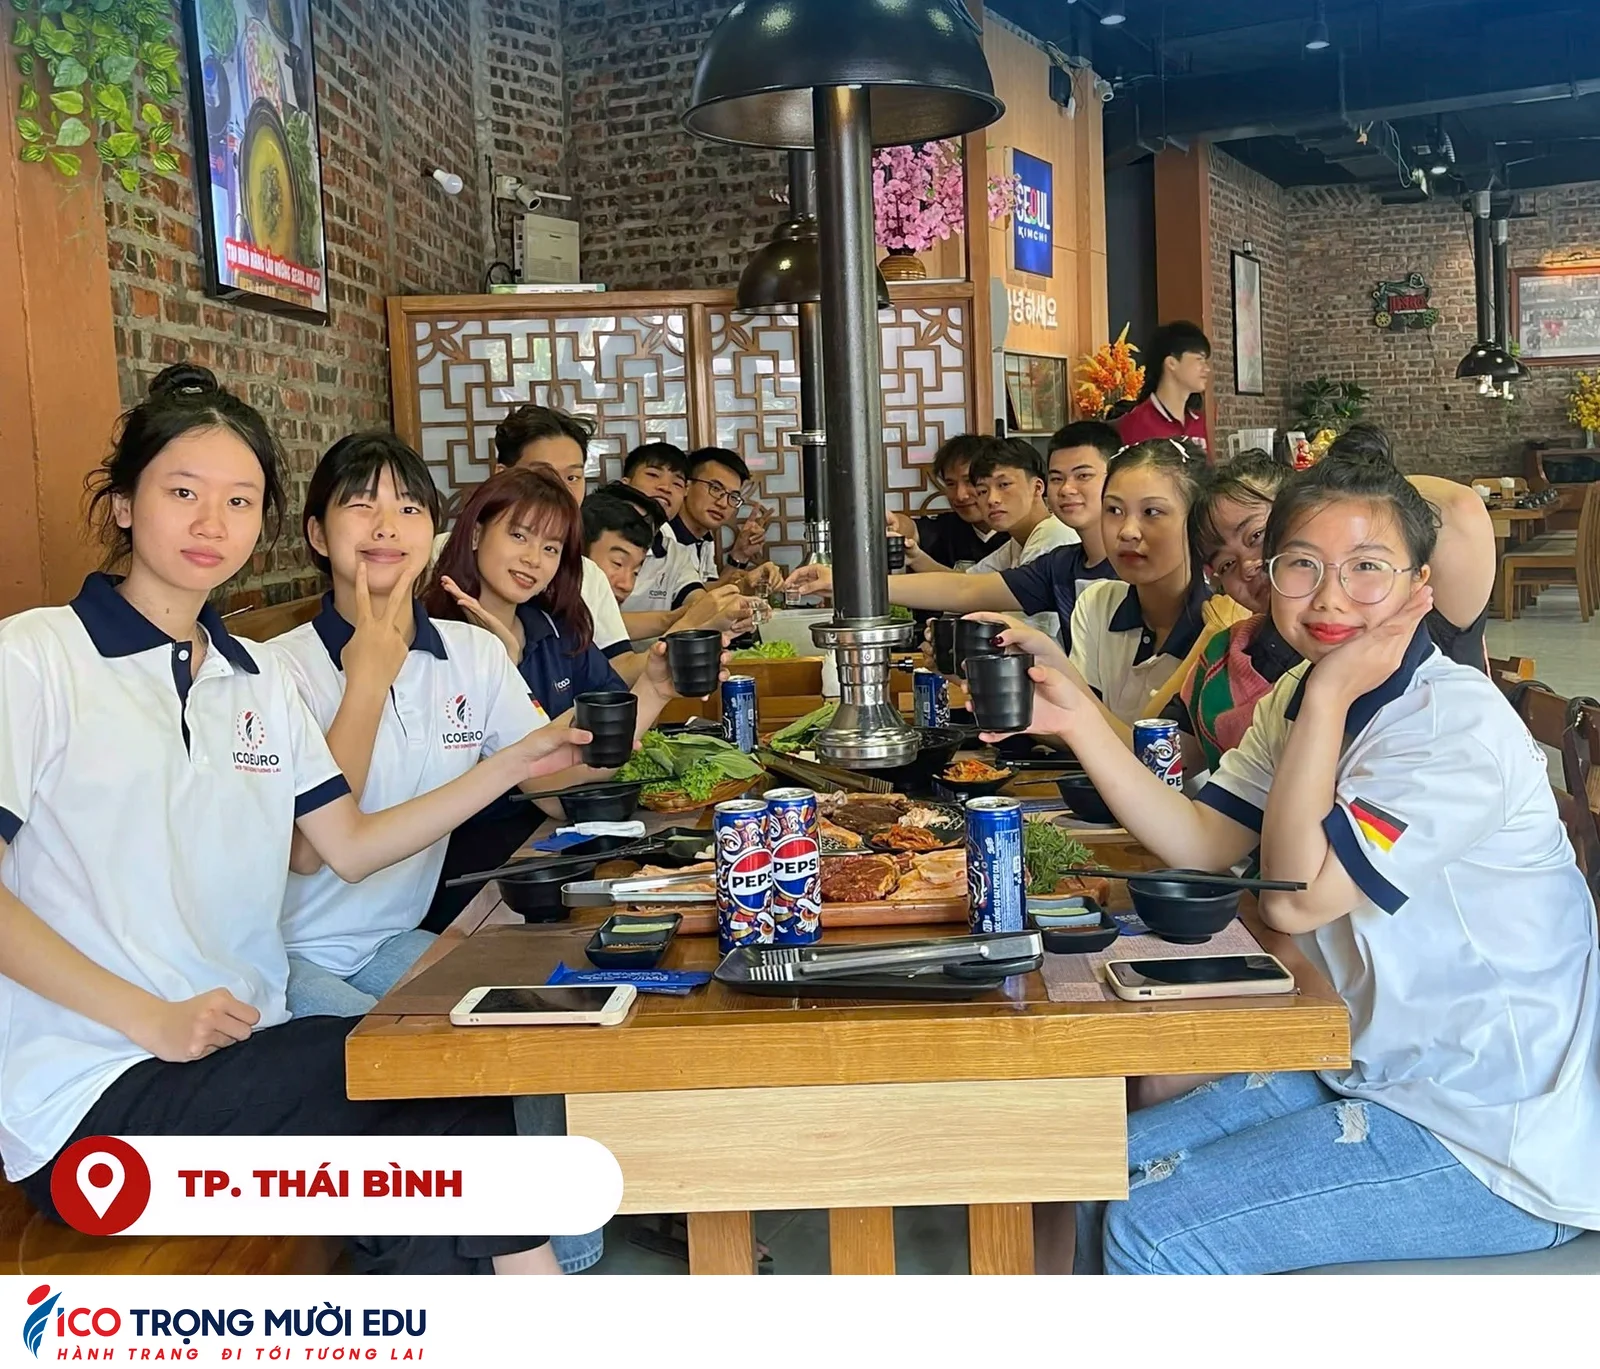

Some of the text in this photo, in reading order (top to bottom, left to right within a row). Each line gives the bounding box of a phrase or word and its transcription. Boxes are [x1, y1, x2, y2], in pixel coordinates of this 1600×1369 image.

[1015, 183, 1051, 230] SEOUL
[1018, 226, 1048, 243] KIMCHI
[1007, 288, 1058, 328] 녕하세요
[232, 751, 280, 766] ICOEURO
